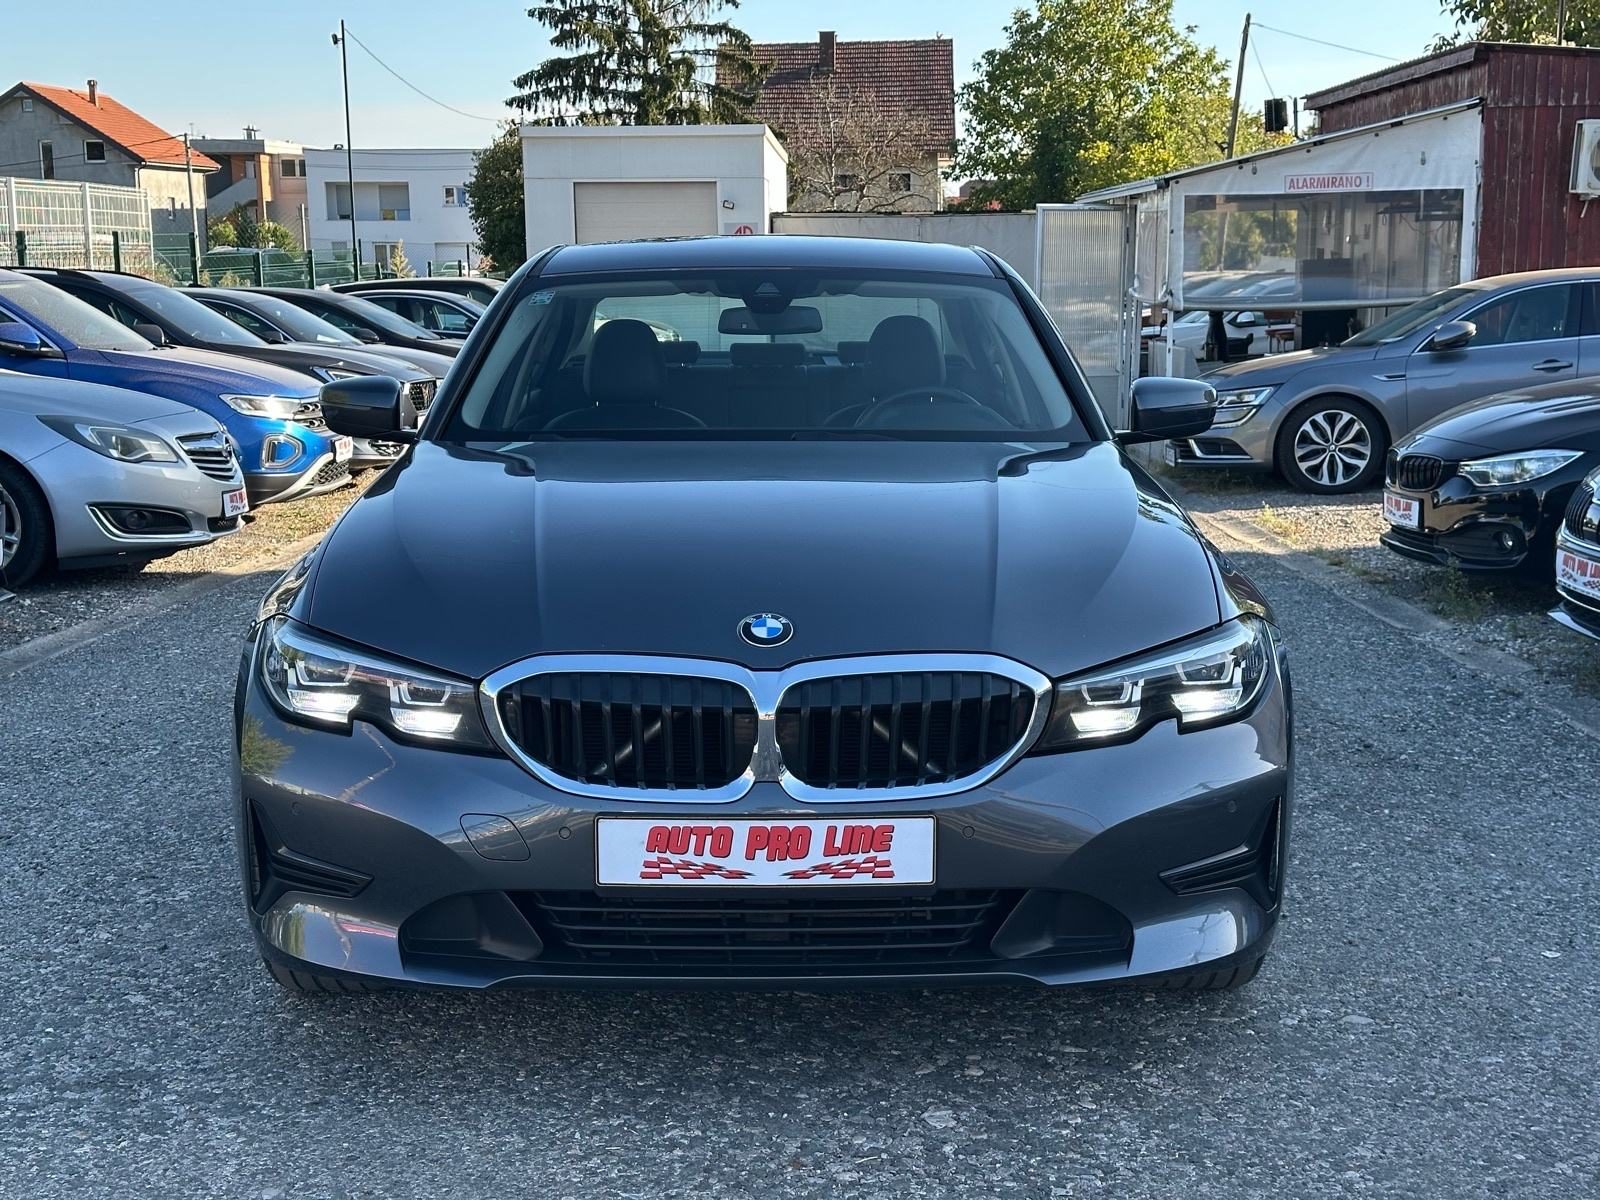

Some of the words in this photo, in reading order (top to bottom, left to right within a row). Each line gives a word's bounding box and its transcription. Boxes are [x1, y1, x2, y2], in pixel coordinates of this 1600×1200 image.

[1288, 175, 1362, 190] ALARMIRANO
[646, 825, 734, 858] AUTO
[745, 826, 812, 861] PRO
[823, 824, 894, 857] LINE
